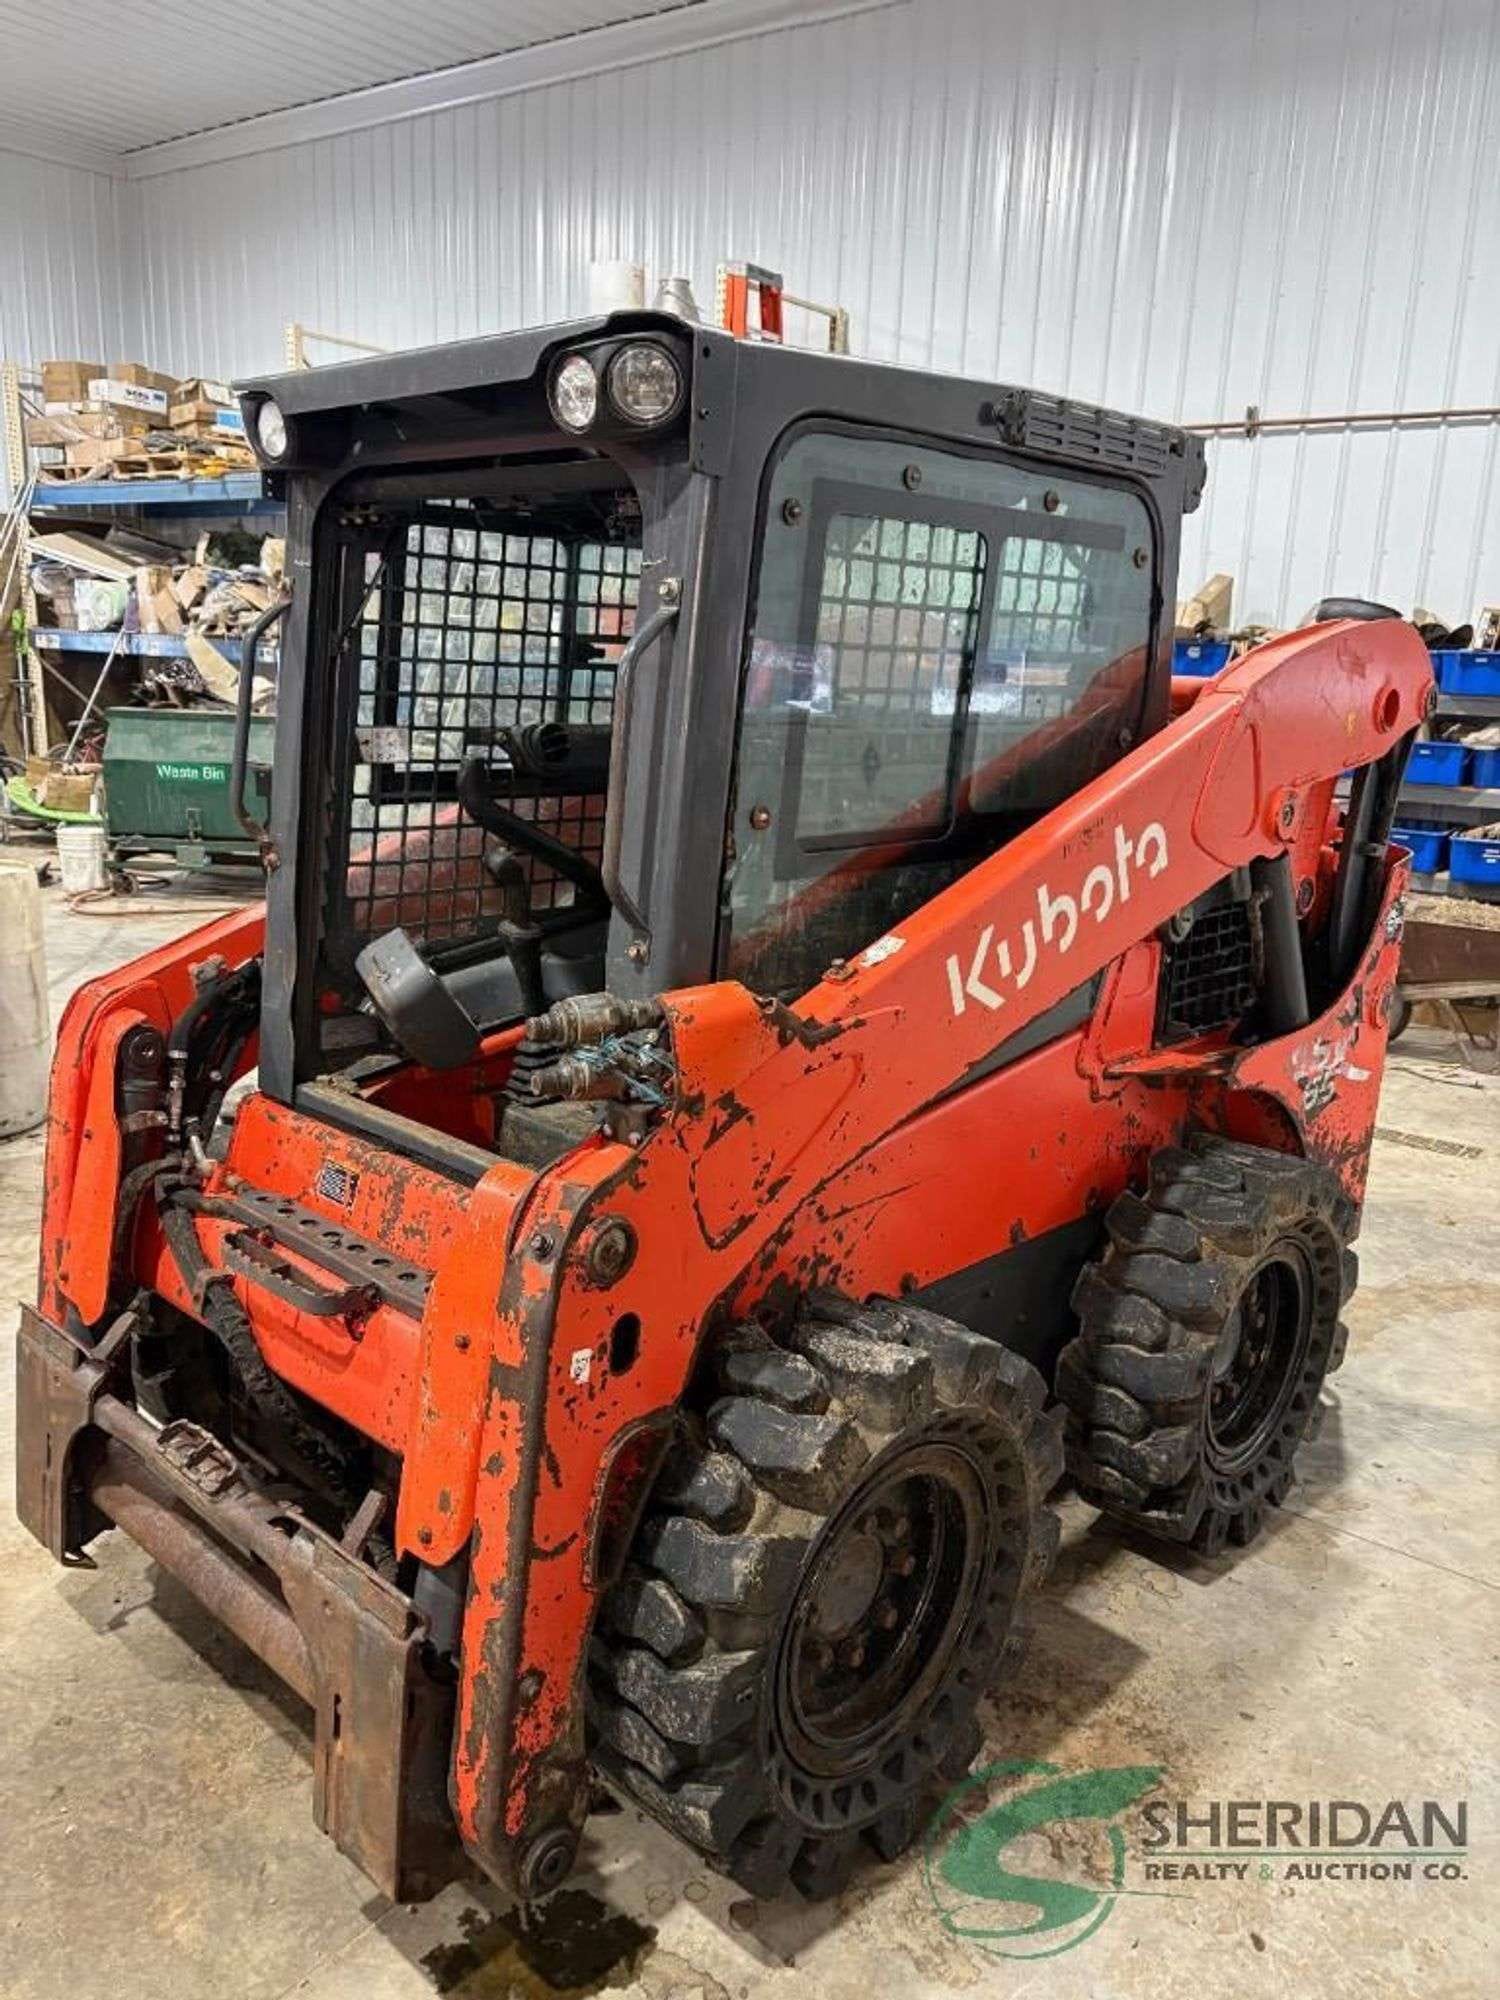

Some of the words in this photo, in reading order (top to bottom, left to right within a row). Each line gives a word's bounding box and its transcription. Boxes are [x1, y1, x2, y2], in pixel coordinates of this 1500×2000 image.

[156, 764, 198, 778] Waste
[202, 766, 225, 780] Bin
[945, 821, 1169, 1017] Kubota
